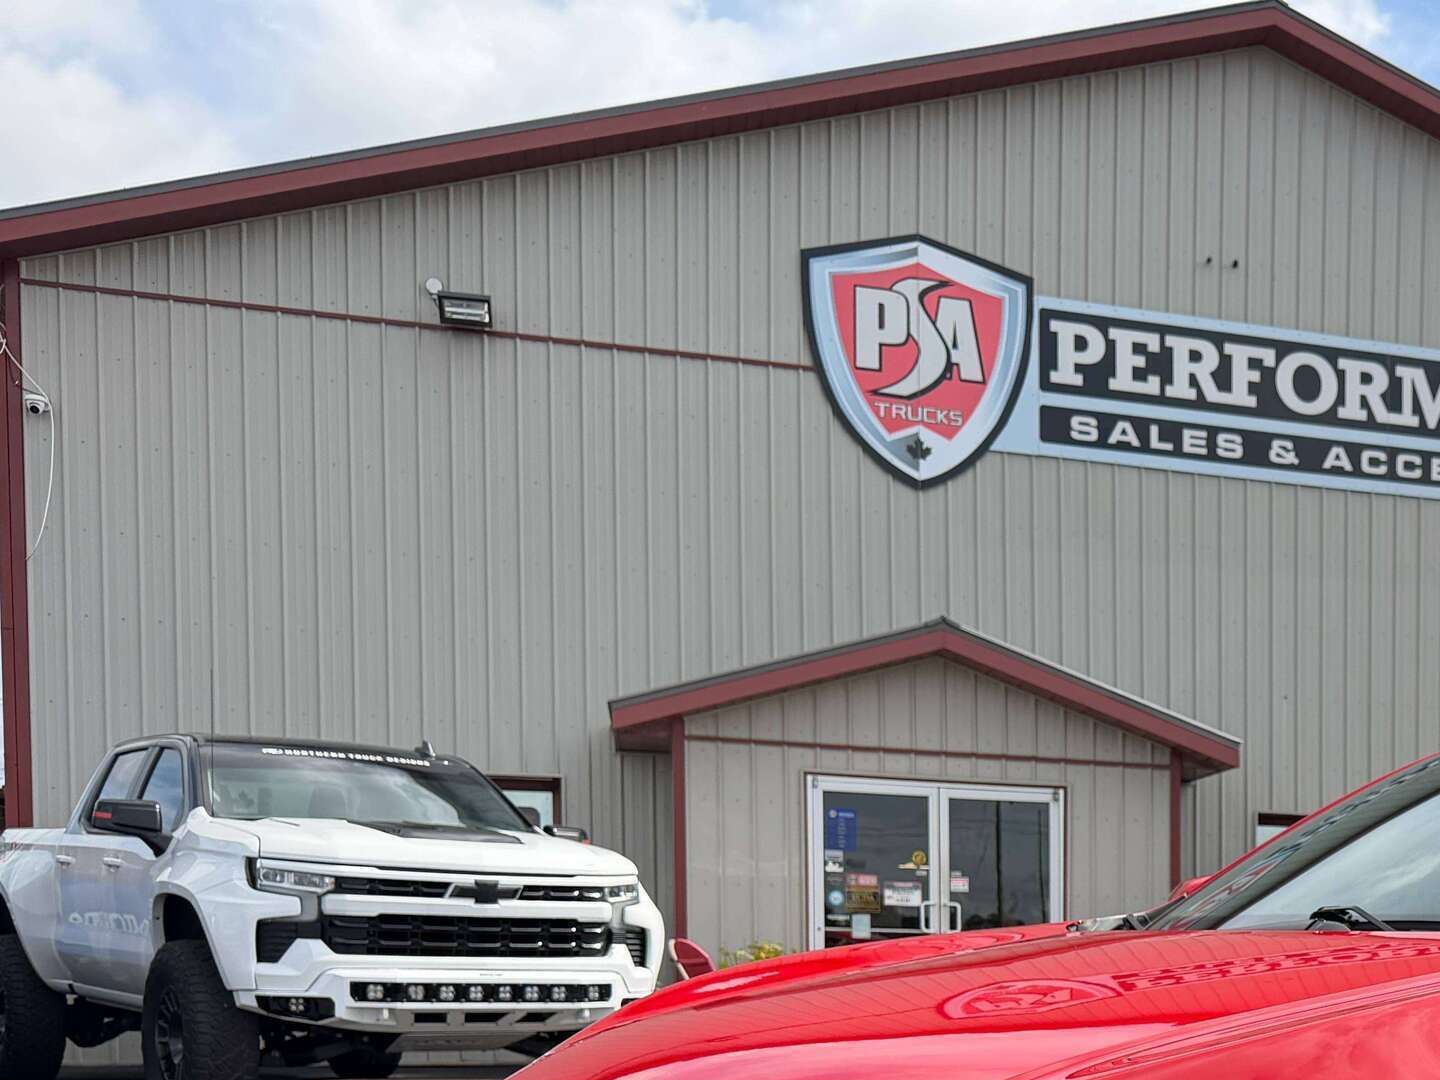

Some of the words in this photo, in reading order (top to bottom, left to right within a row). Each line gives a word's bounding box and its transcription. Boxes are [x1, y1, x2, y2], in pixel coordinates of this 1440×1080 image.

[854, 278, 985, 398] PSA
[874, 401, 964, 427] TRUCKS
[1069, 414, 1244, 460] SALES
[1268, 439, 1299, 465] &
